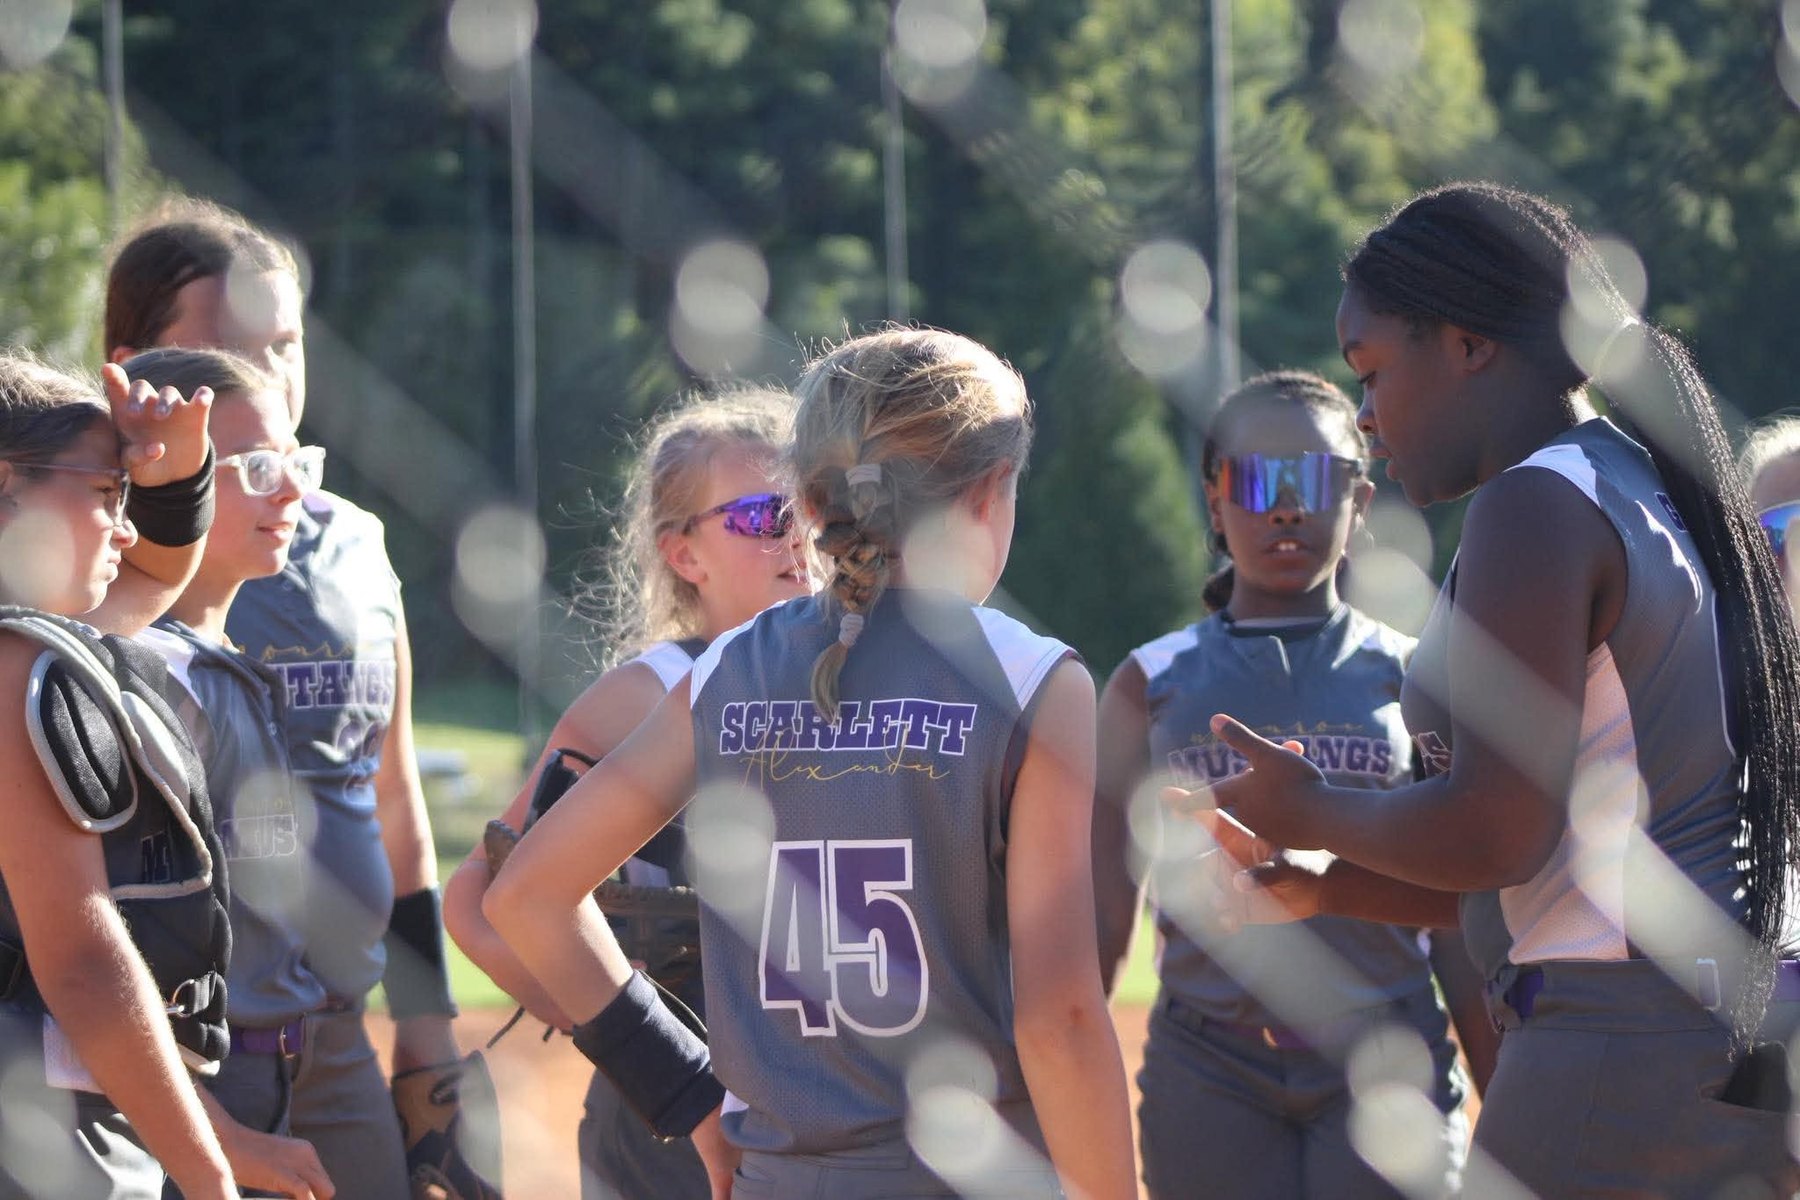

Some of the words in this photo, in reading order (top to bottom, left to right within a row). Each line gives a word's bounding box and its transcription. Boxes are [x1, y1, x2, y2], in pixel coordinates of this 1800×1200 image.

[719, 698, 977, 756] SCARLETT
[740, 721, 950, 797] Alexander
[758, 838, 929, 1037] 45
